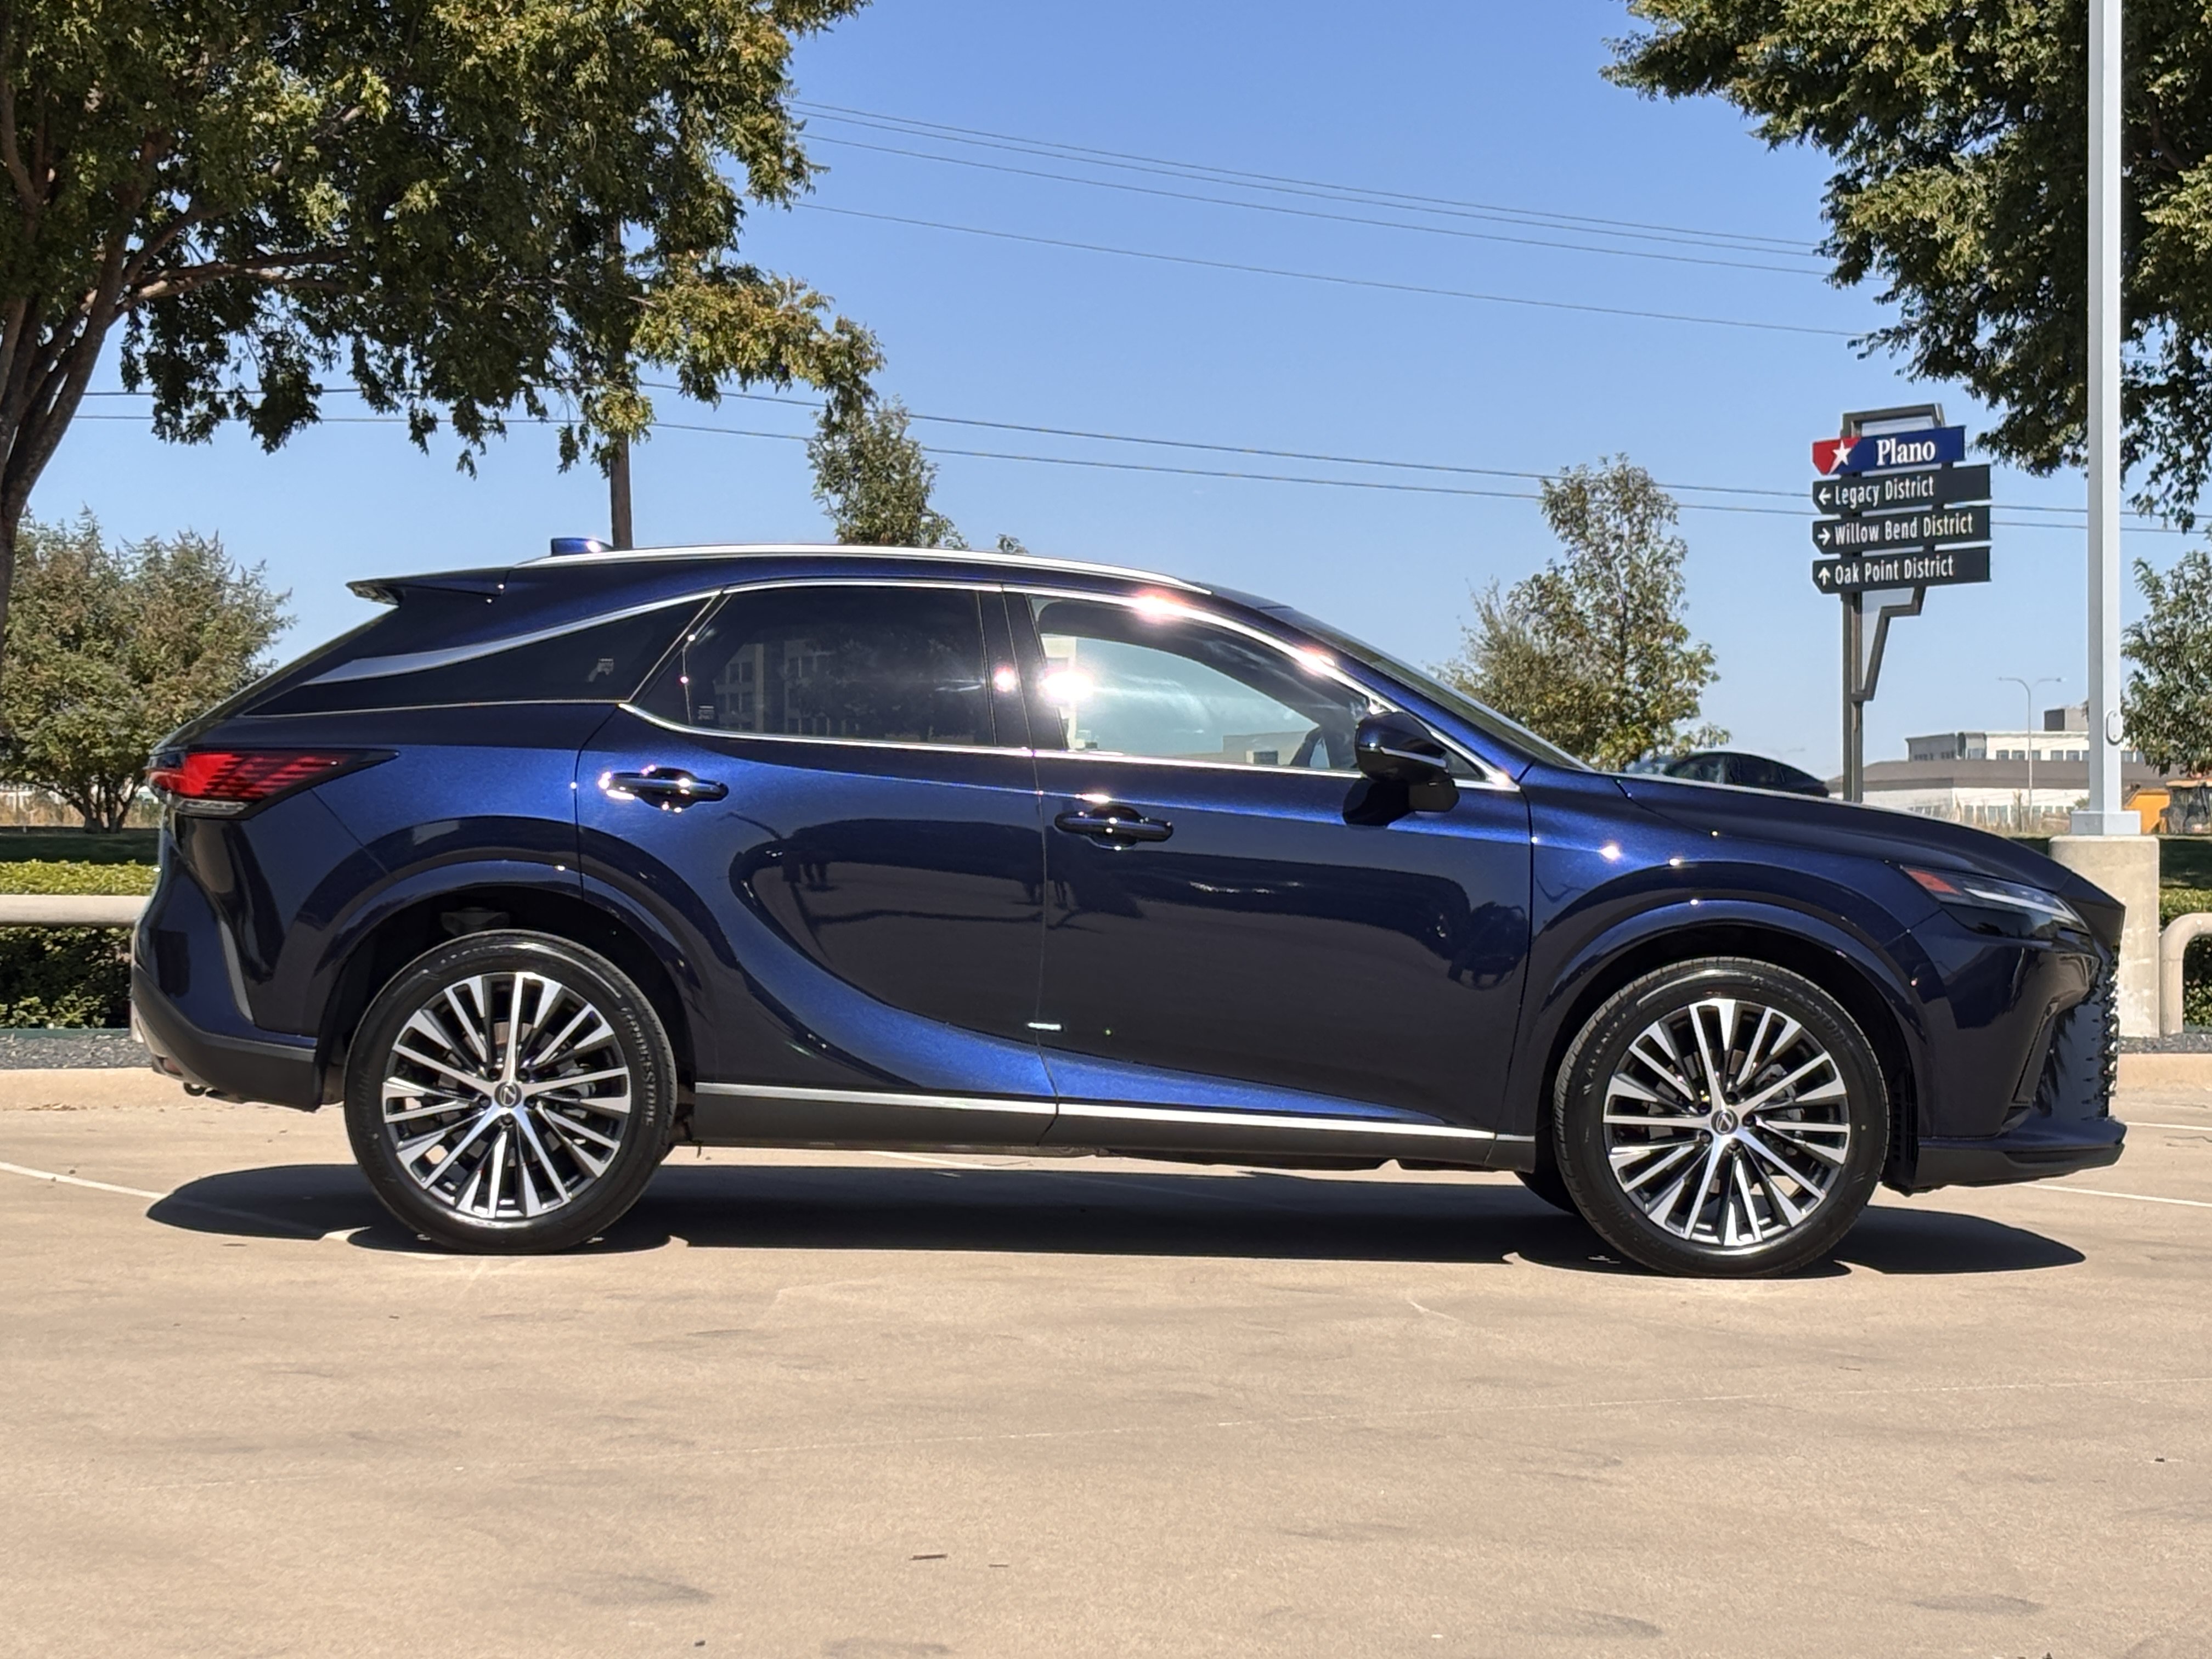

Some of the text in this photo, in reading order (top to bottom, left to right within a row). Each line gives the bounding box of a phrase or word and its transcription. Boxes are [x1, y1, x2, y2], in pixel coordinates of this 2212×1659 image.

[1876, 438, 1936, 466] Plano
[1835, 476, 1934, 509] Legacy District
[1835, 512, 1973, 545] Willow Bend District
[1835, 555, 1954, 584] Oak Point District
